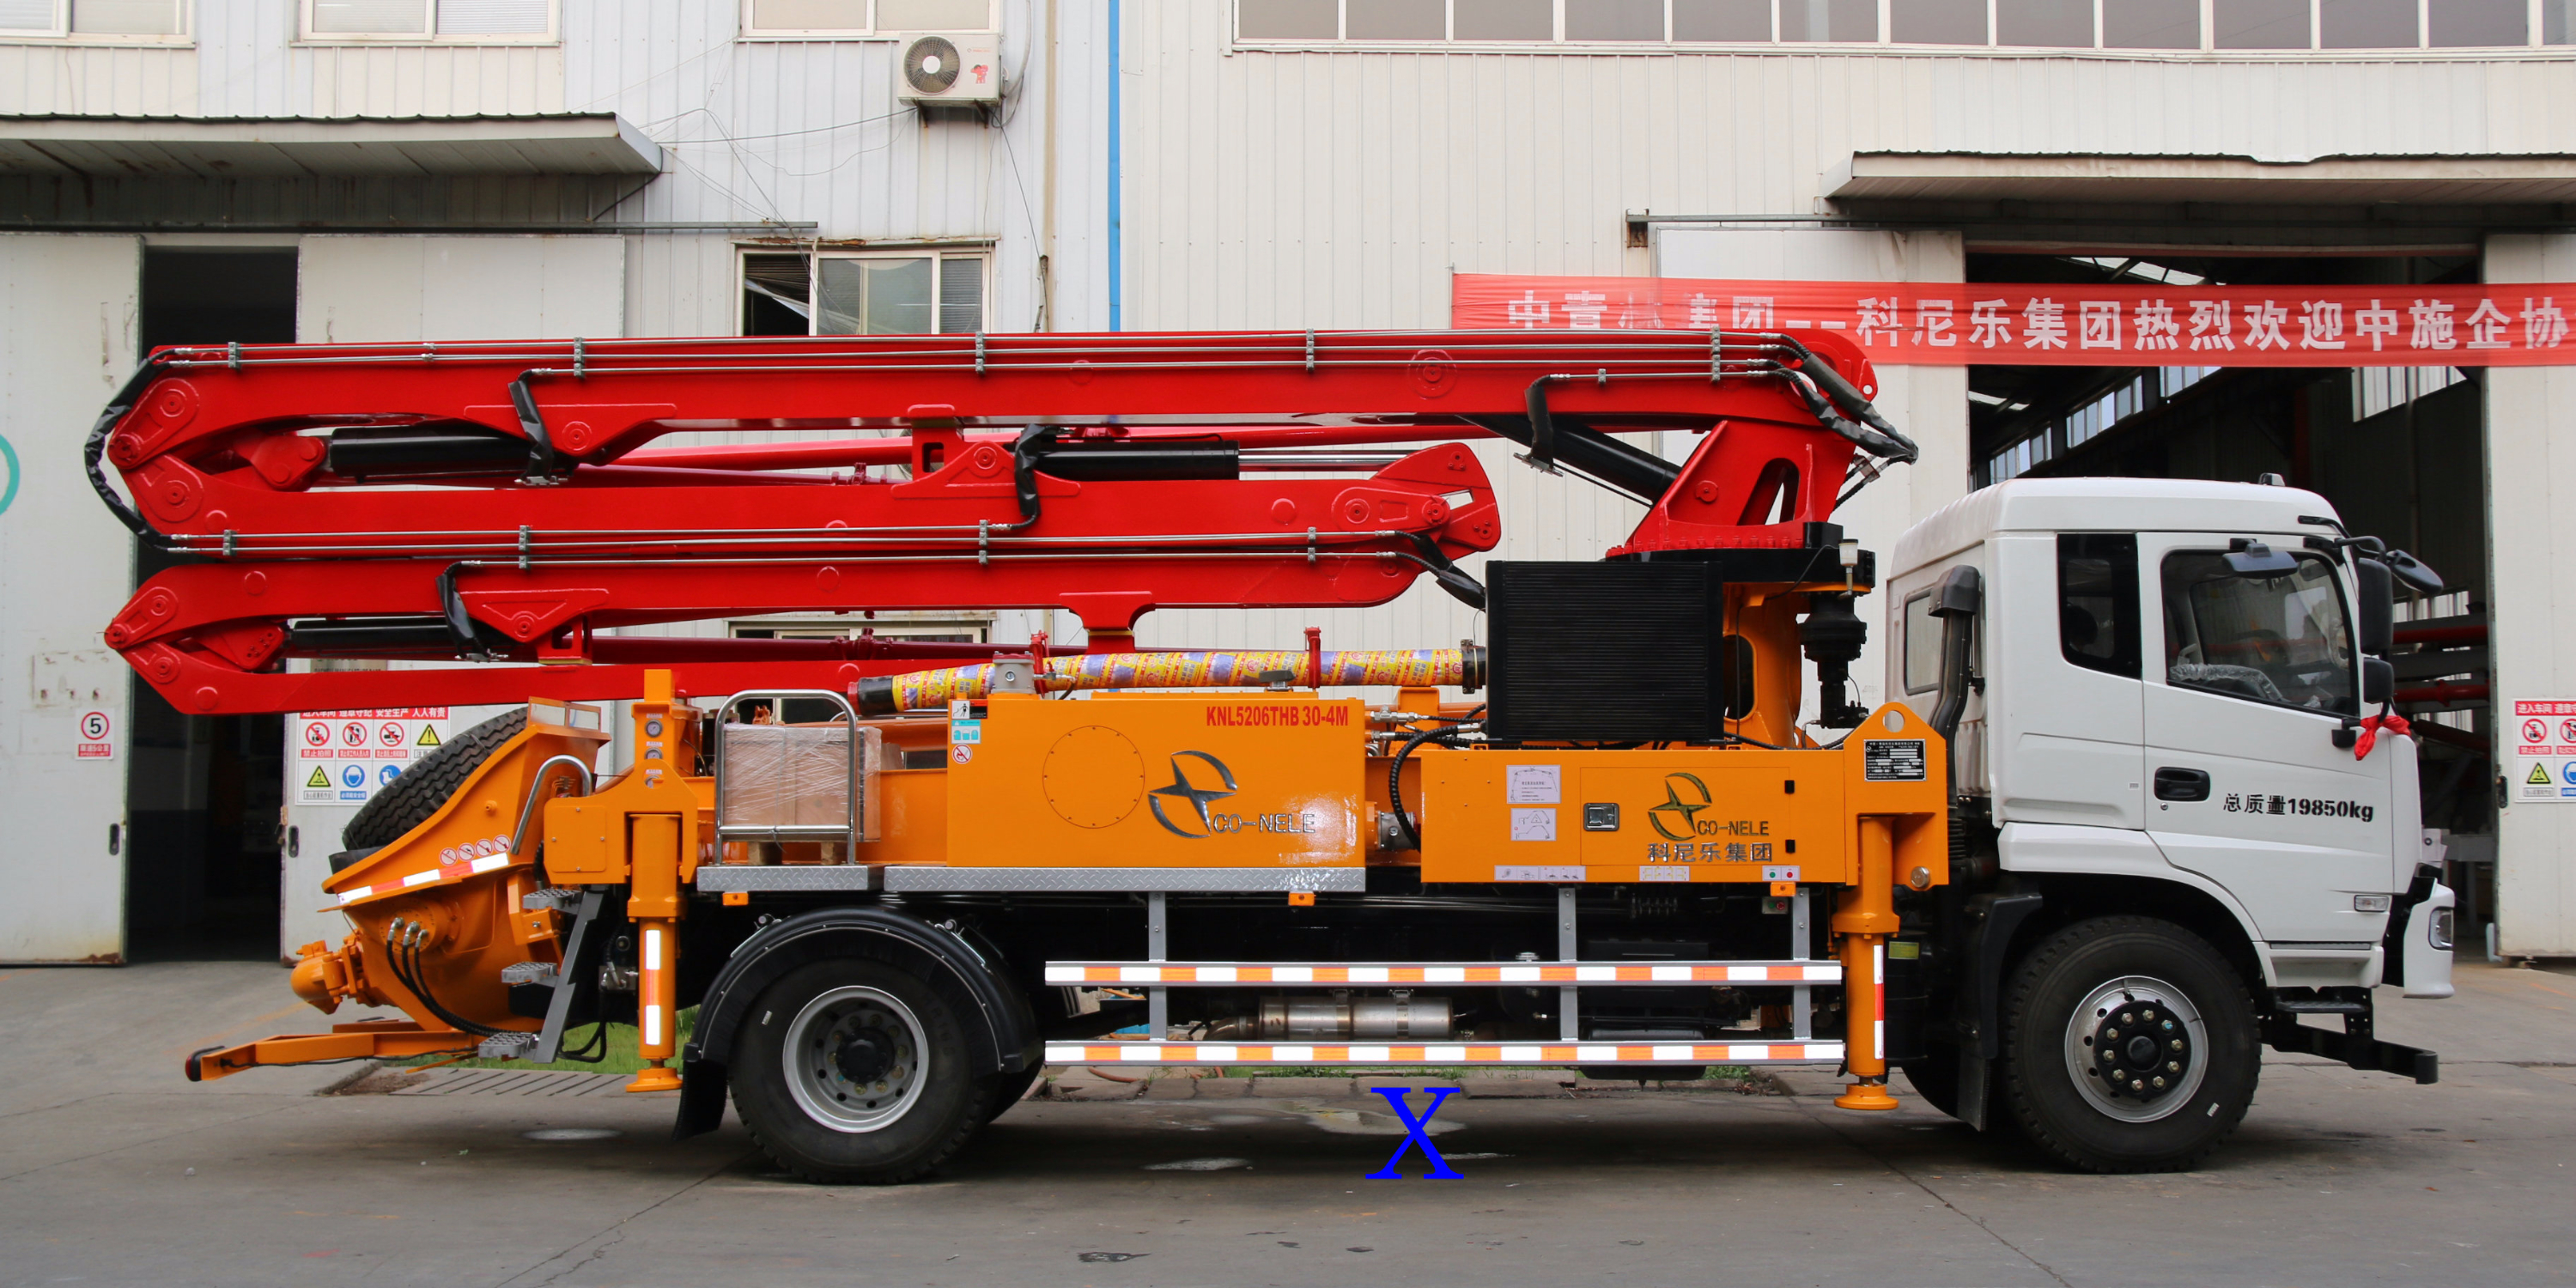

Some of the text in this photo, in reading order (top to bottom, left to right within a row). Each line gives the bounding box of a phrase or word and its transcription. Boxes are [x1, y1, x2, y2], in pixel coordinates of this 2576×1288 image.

[376, 708, 409, 717] 安全生产
[412, 707, 445, 717] 人人有责
[1206, 706, 1348, 726] KNL5206THB 30-4M
[90, 718, 101, 734] 5
[2223, 793, 2373, 823] 总质量19850kg
[1213, 813, 1315, 833] CO-NELE
[1697, 820, 1770, 835] CO-NELE
[1648, 842, 1772, 862] 科尼乐集团
